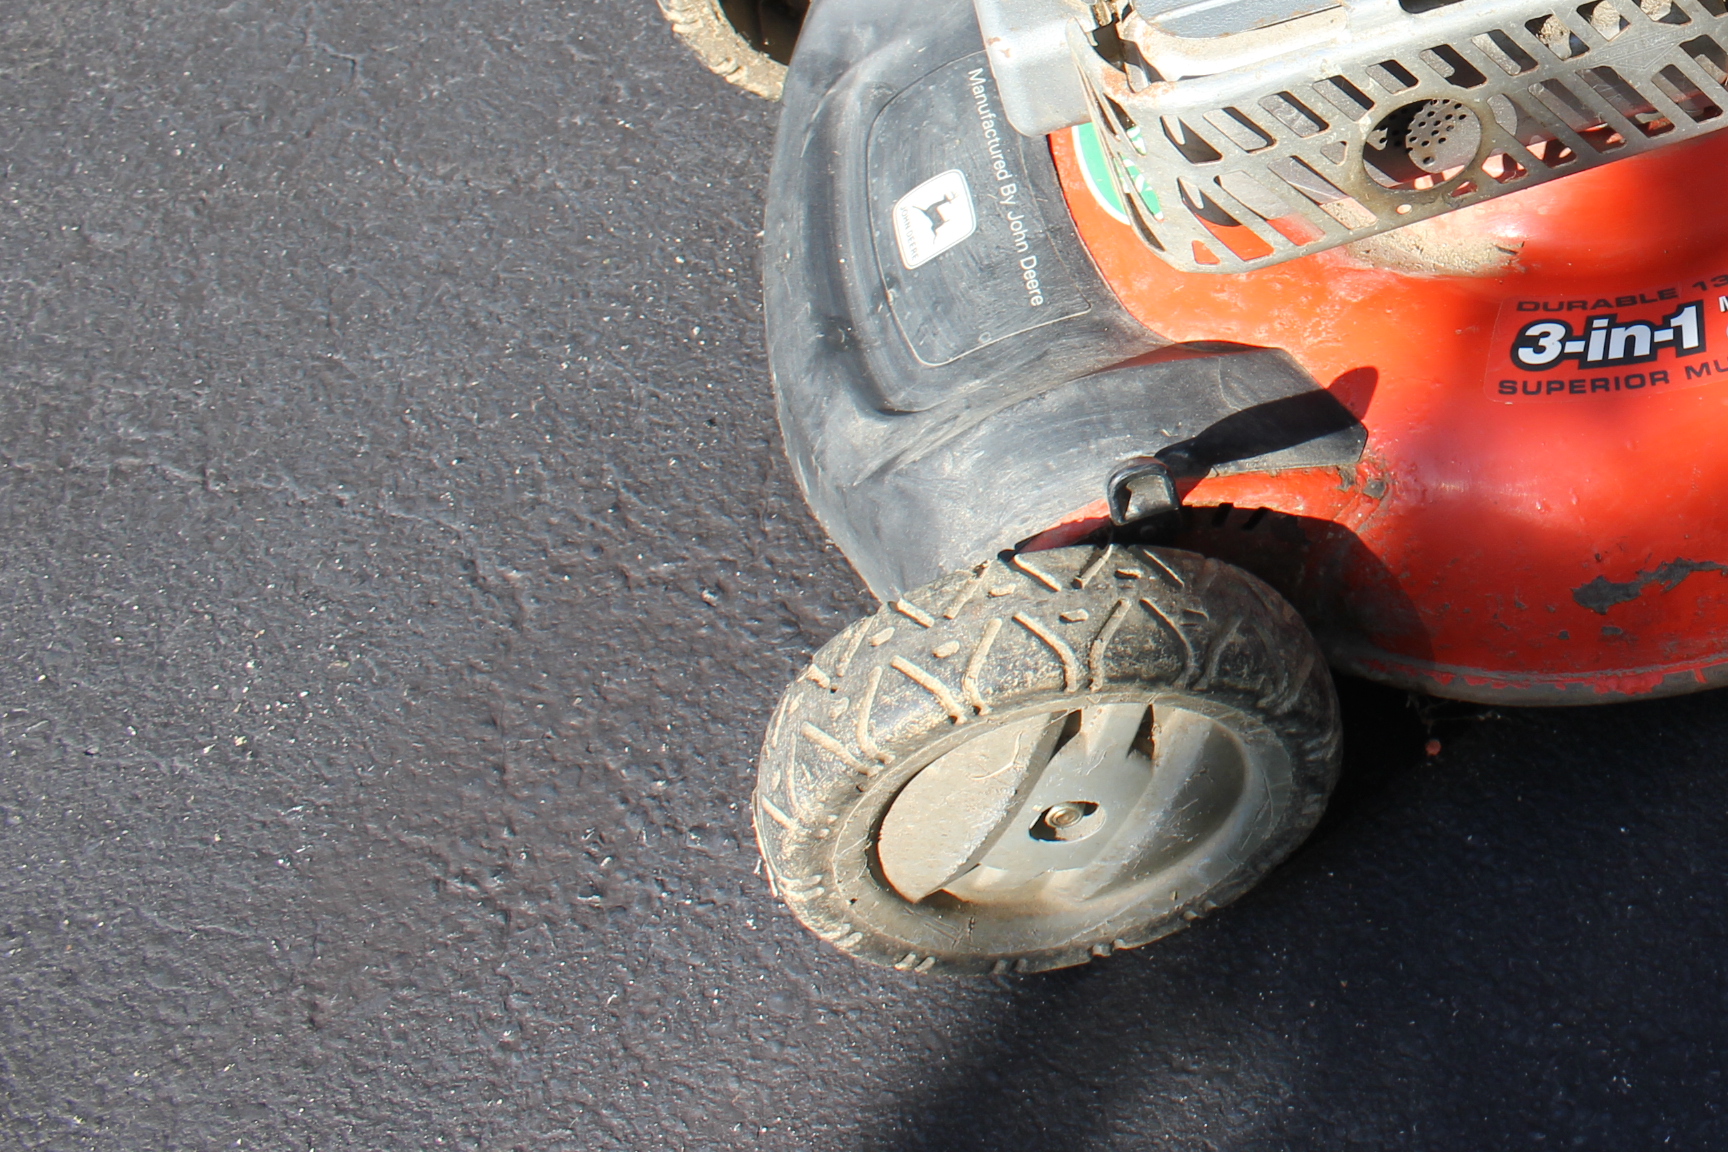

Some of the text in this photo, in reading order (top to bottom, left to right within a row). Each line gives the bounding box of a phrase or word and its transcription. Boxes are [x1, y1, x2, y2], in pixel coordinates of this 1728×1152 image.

[968, 67, 1044, 307] Manufactured By John Deere
[899, 205, 919, 260] JOHN DEERE
[1516, 287, 1679, 312] DURABLE
[1513, 303, 1703, 368] 3-in-1
[1498, 371, 1670, 395] SUPERIOR
